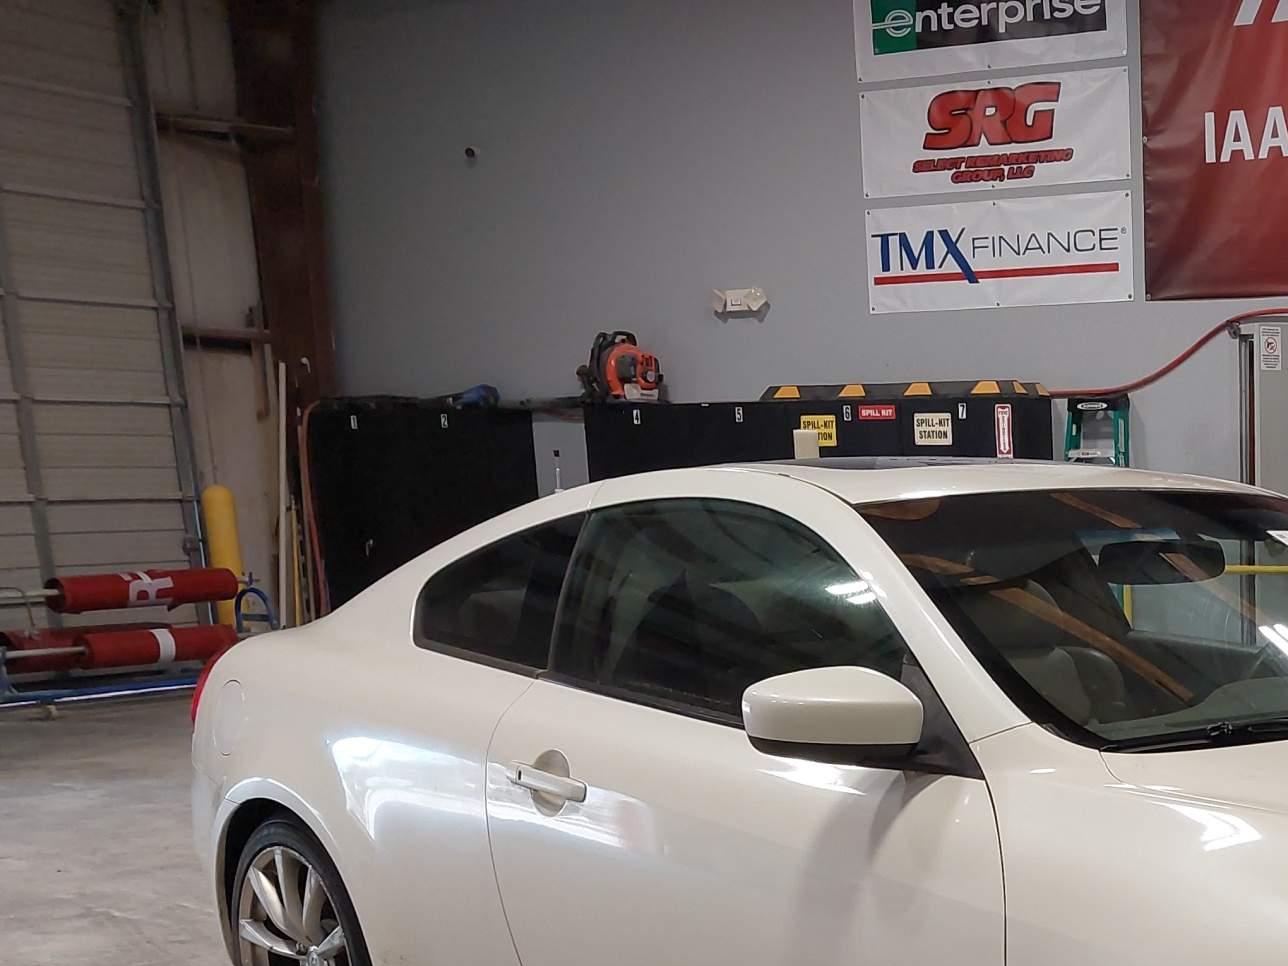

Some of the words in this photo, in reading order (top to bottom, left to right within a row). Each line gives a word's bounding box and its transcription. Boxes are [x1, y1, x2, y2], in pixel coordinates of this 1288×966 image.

[872, 0, 1102, 37] enterprise
[922, 82, 1062, 151] SRG
[1007, 166, 1035, 179] LLC
[861, 409, 881, 417] SPILL
[802, 420, 834, 430] SPILL-KIT
[916, 418, 950, 428] SPILL-KIT
[918, 430, 949, 440] STATION
